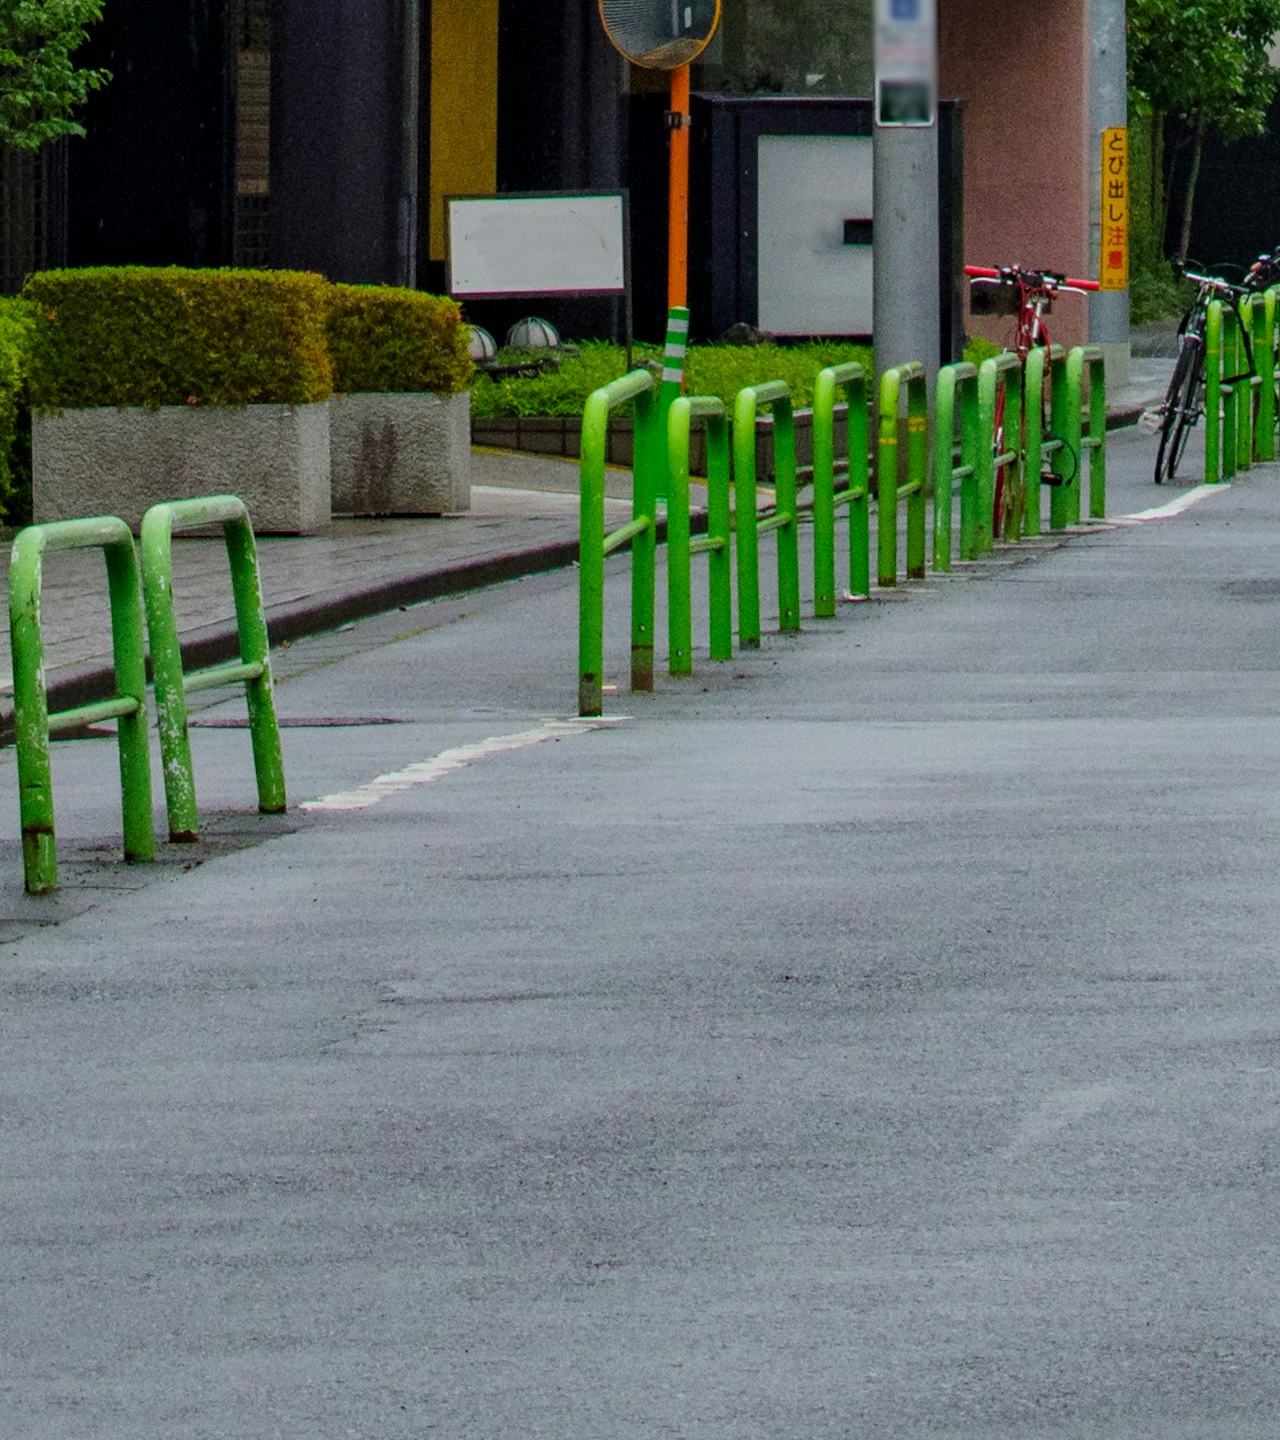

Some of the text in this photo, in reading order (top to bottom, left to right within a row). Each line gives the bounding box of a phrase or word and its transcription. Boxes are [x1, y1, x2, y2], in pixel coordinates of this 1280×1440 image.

[1107, 132, 1125, 271] とび出し注意
